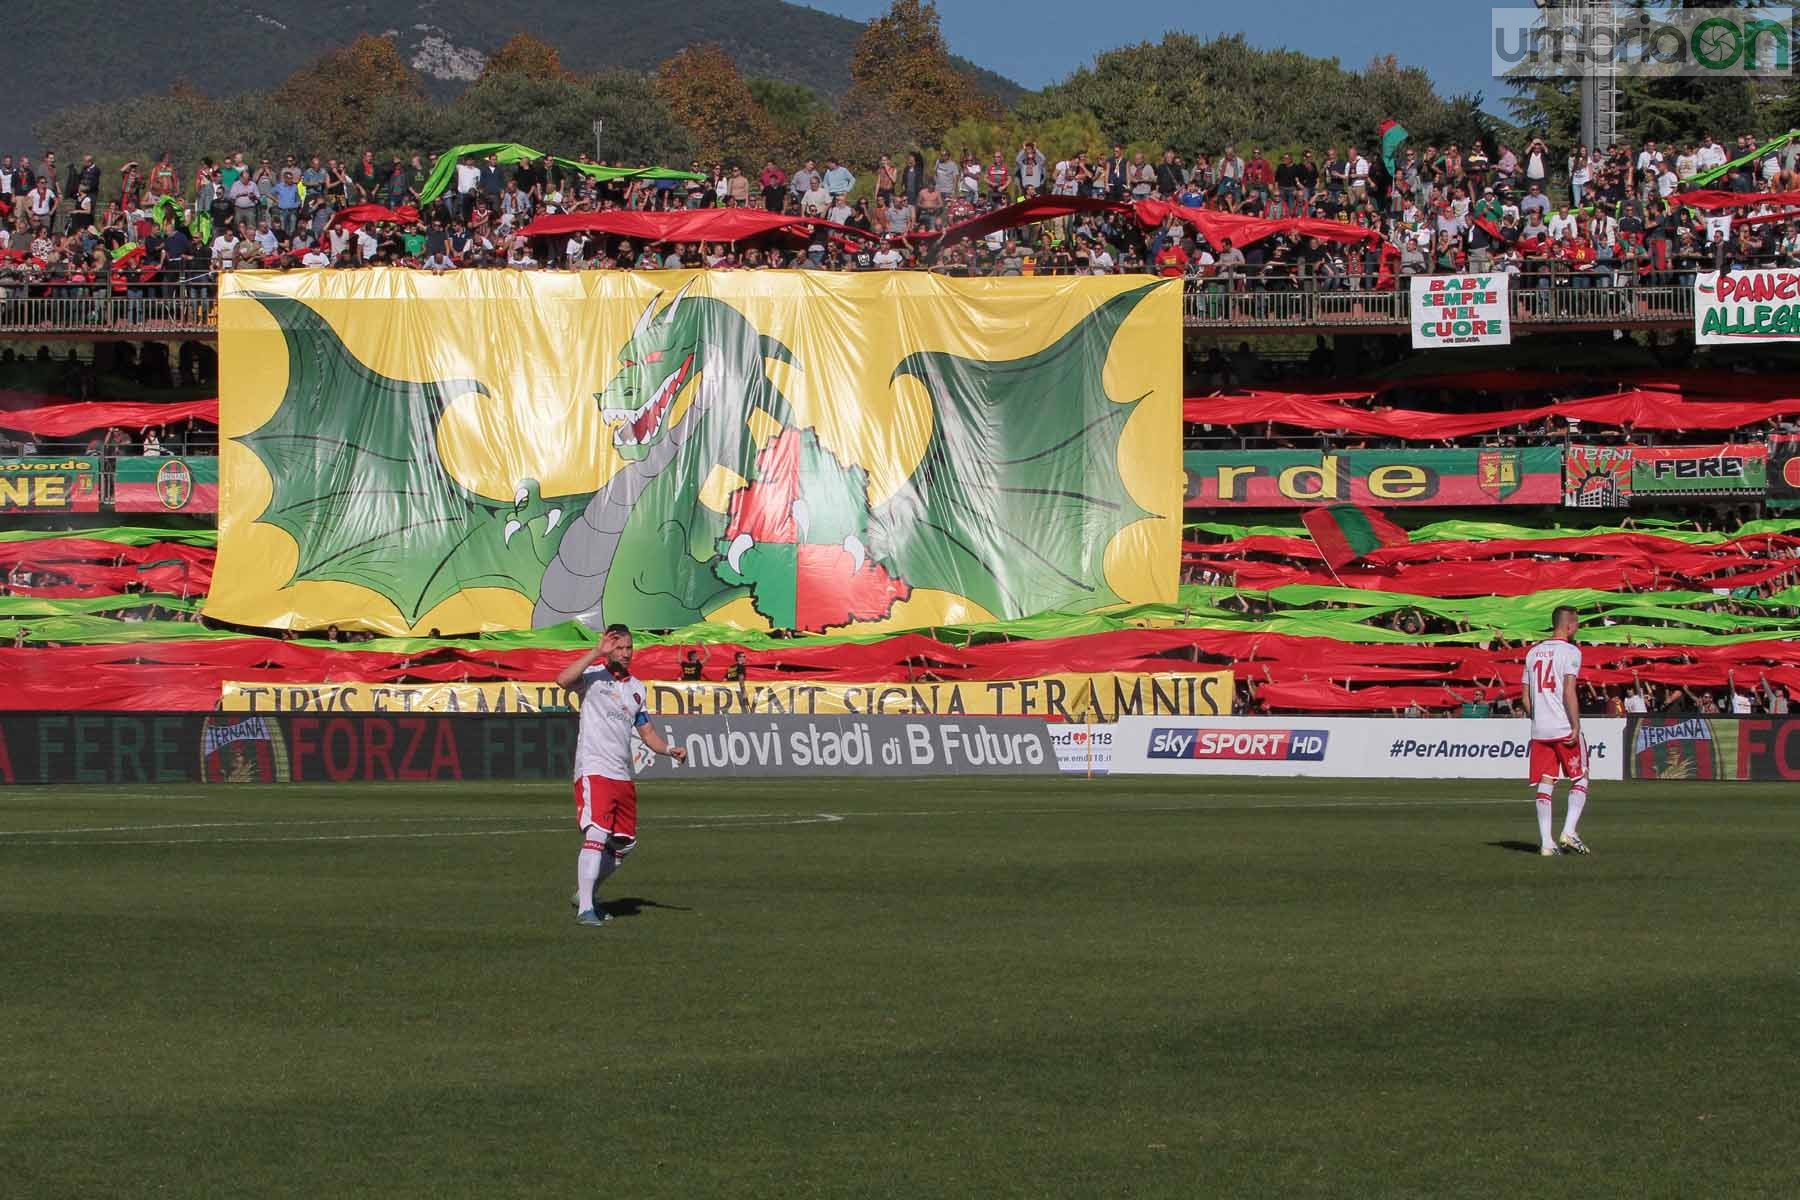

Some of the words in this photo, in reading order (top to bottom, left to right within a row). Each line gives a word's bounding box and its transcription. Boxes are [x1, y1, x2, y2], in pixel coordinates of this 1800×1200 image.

[1422, 291, 1497, 307] SEMPRE
[1429, 277, 1492, 291] BABY
[1716, 273, 1800, 303] PANZ
[1421, 319, 1502, 337] CUORE
[1442, 306, 1480, 320] NEL
[1183, 455, 1427, 499] rde
[1533, 659, 1556, 693] 14
[844, 684, 965, 714] SIGNA
[987, 676, 1218, 724] TERAMNIS
[207, 715, 265, 748] TERNANA
[664, 725, 681, 768] i
[685, 723, 783, 767] nuovi
[790, 722, 873, 766] stadi
[881, 737, 902, 765] di
[906, 723, 934, 765] B
[939, 724, 1044, 765] Futura
[1152, 730, 1193, 757] sky
[1199, 733, 1284, 755] SPORT
[1291, 736, 1322, 754] HD
[1640, 719, 1705, 747] TERNANA
[38, 717, 187, 783] FERE
[291, 718, 462, 782] FORZA
[484, 718, 578, 780] FER
